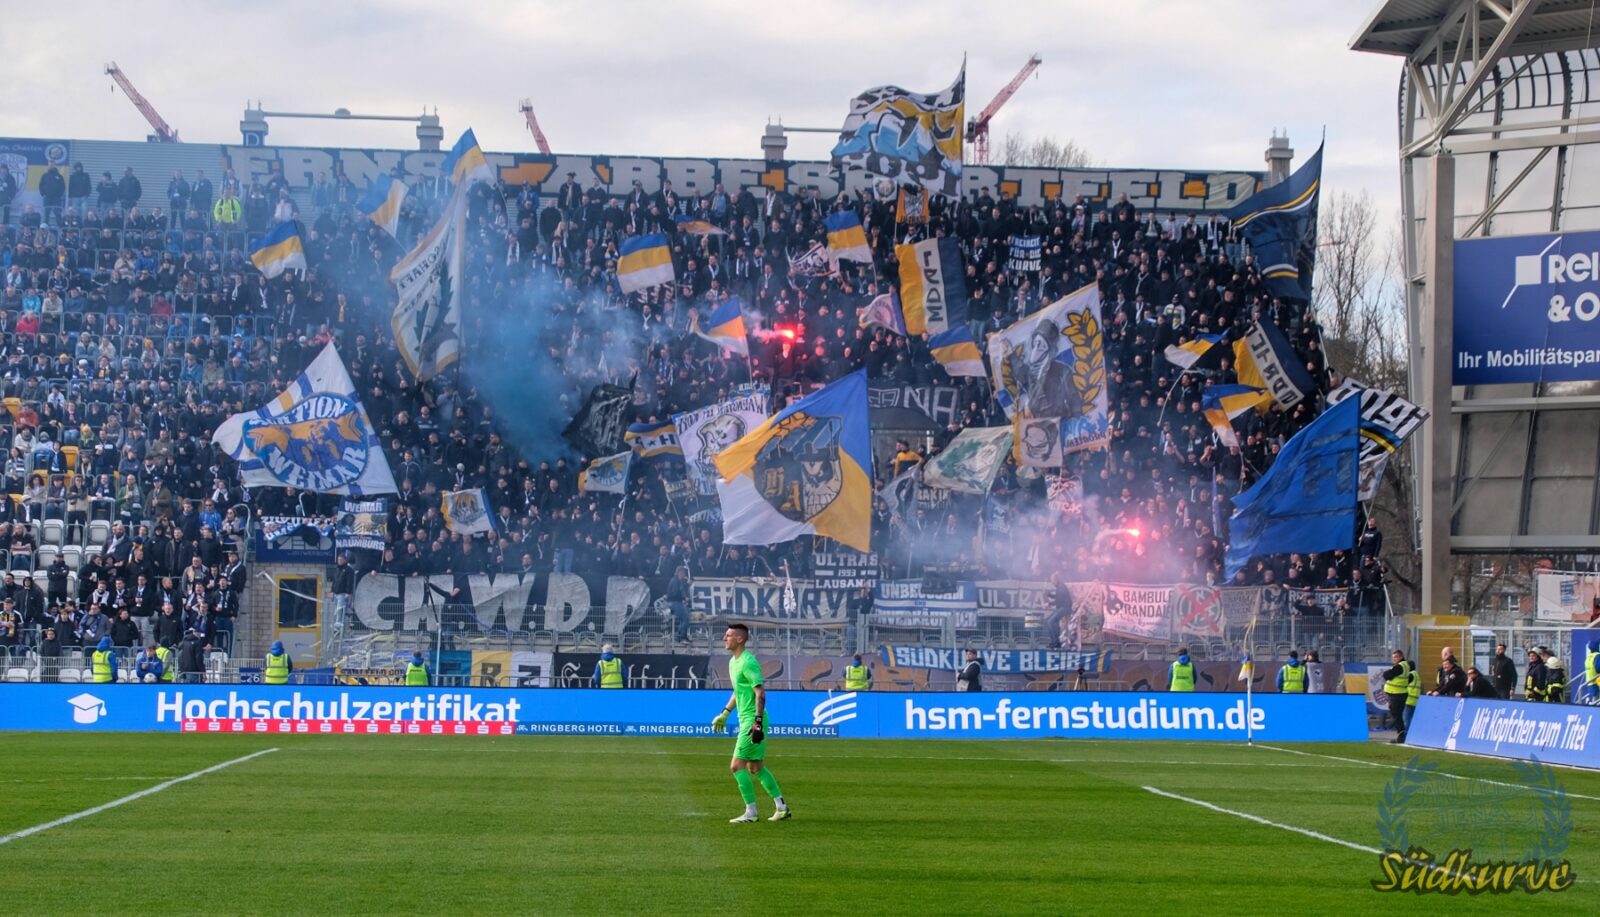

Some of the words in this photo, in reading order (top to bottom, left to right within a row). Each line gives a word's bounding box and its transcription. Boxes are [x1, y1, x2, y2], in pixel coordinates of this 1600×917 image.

[1008, 258, 1042, 272] KURVE
[1547, 294, 1571, 323] &
[1458, 351, 1483, 369] Ihr
[268, 444, 367, 491] WEIMAR
[344, 500, 383, 513] WEIMAR
[335, 538, 386, 551] NAUMBURG
[815, 553, 879, 567] ULTRAS
[838, 569, 857, 577] 1993
[693, 584, 860, 620] SÜDKURV
[895, 645, 1012, 672] SÜDKUVE
[1019, 650, 1098, 672] BLEIBT
[156, 689, 521, 723] Hochschulzertifikat
[905, 698, 1266, 731] hsm-fernstudium.de
[530, 721, 586, 733] RINGBERG
[587, 722, 622, 734] HOTEL
[639, 724, 694, 734] RINGBERG
[696, 725, 729, 735] HOL
[803, 726, 837, 736] HOTEL
[1468, 706, 1492, 740] Mit
[1489, 706, 1537, 752] Köpfchen
[1533, 719, 1562, 748] zum
[1560, 713, 1593, 751] Titel
